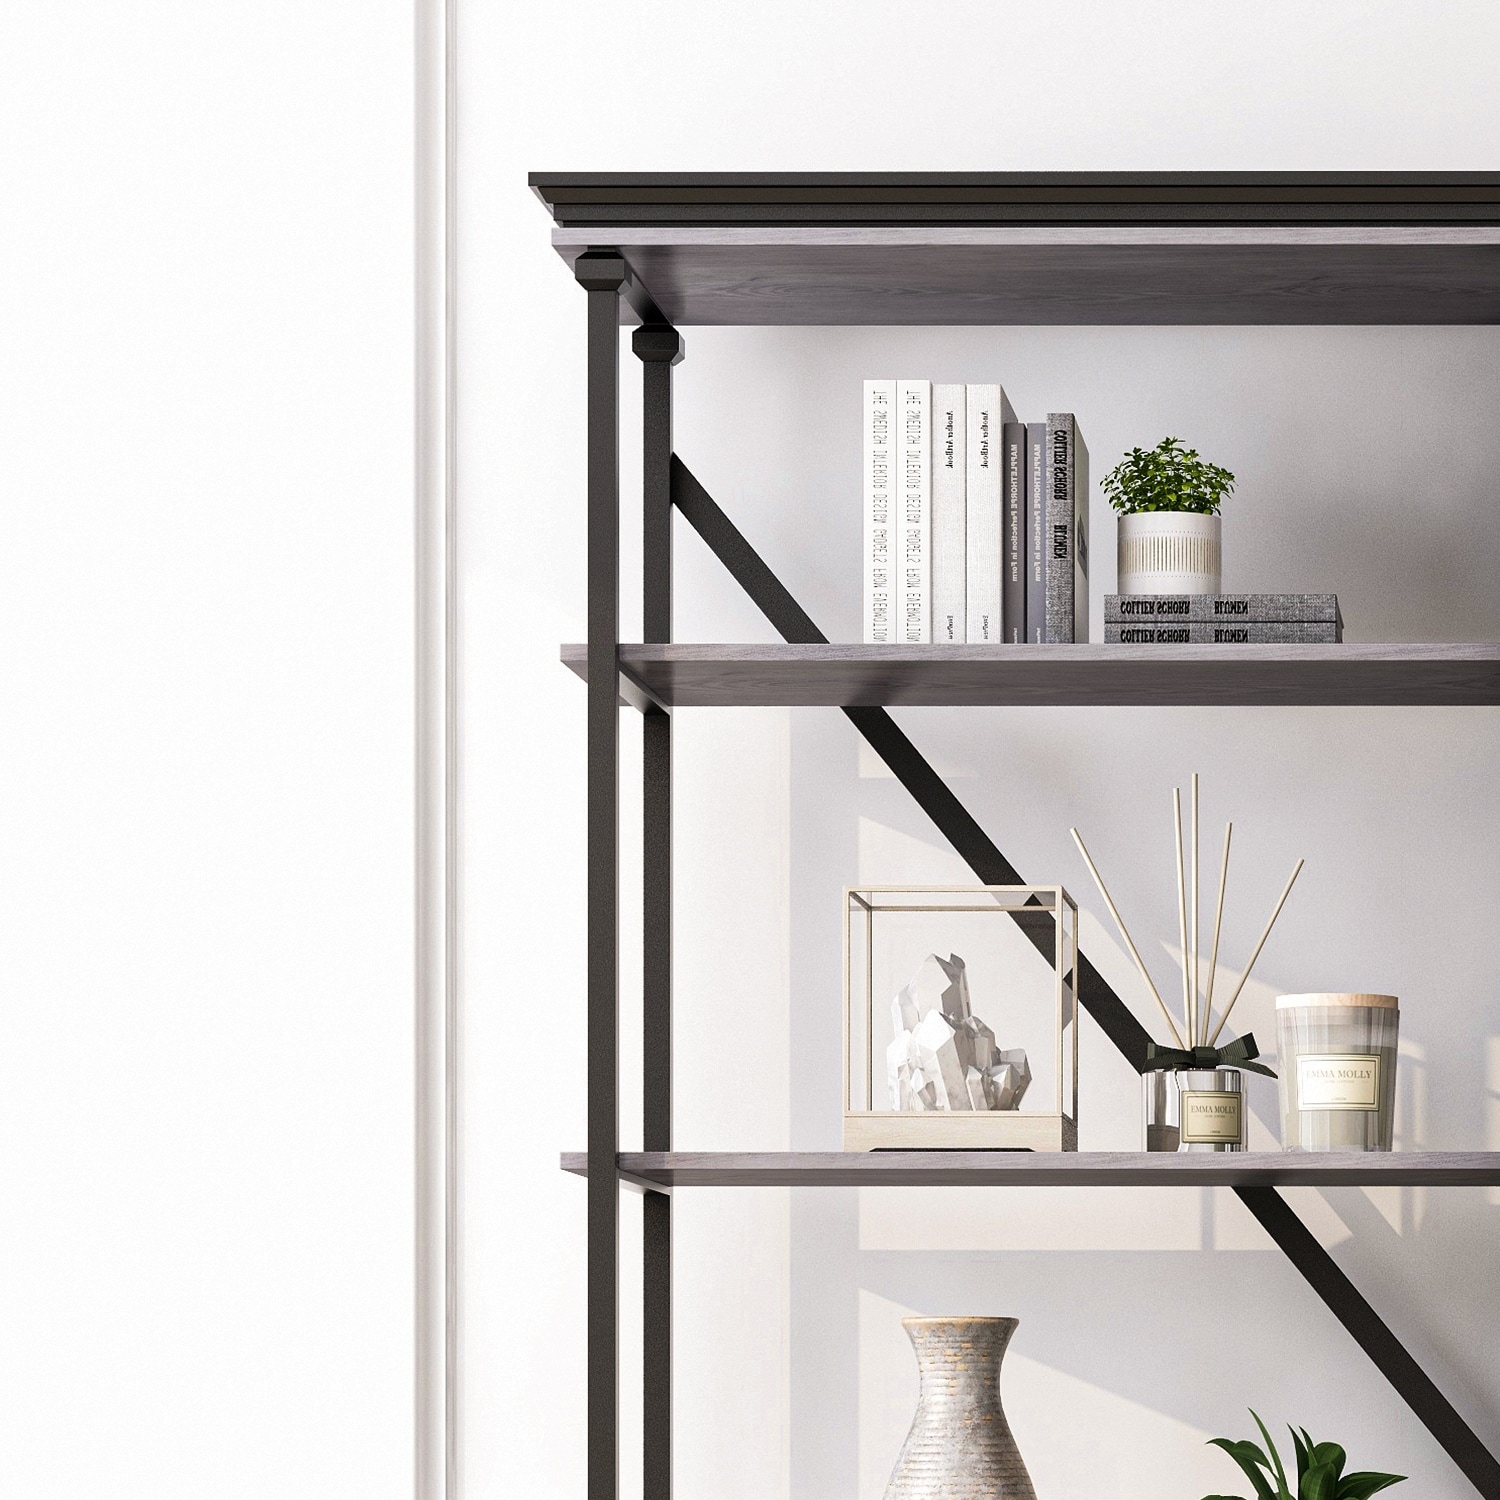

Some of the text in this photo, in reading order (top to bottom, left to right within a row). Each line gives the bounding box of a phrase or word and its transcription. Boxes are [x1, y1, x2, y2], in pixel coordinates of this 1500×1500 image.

[1306, 1070, 1372, 1079] EMMA MOLLY
[1214, 1105, 1236, 1114] MOLLY
